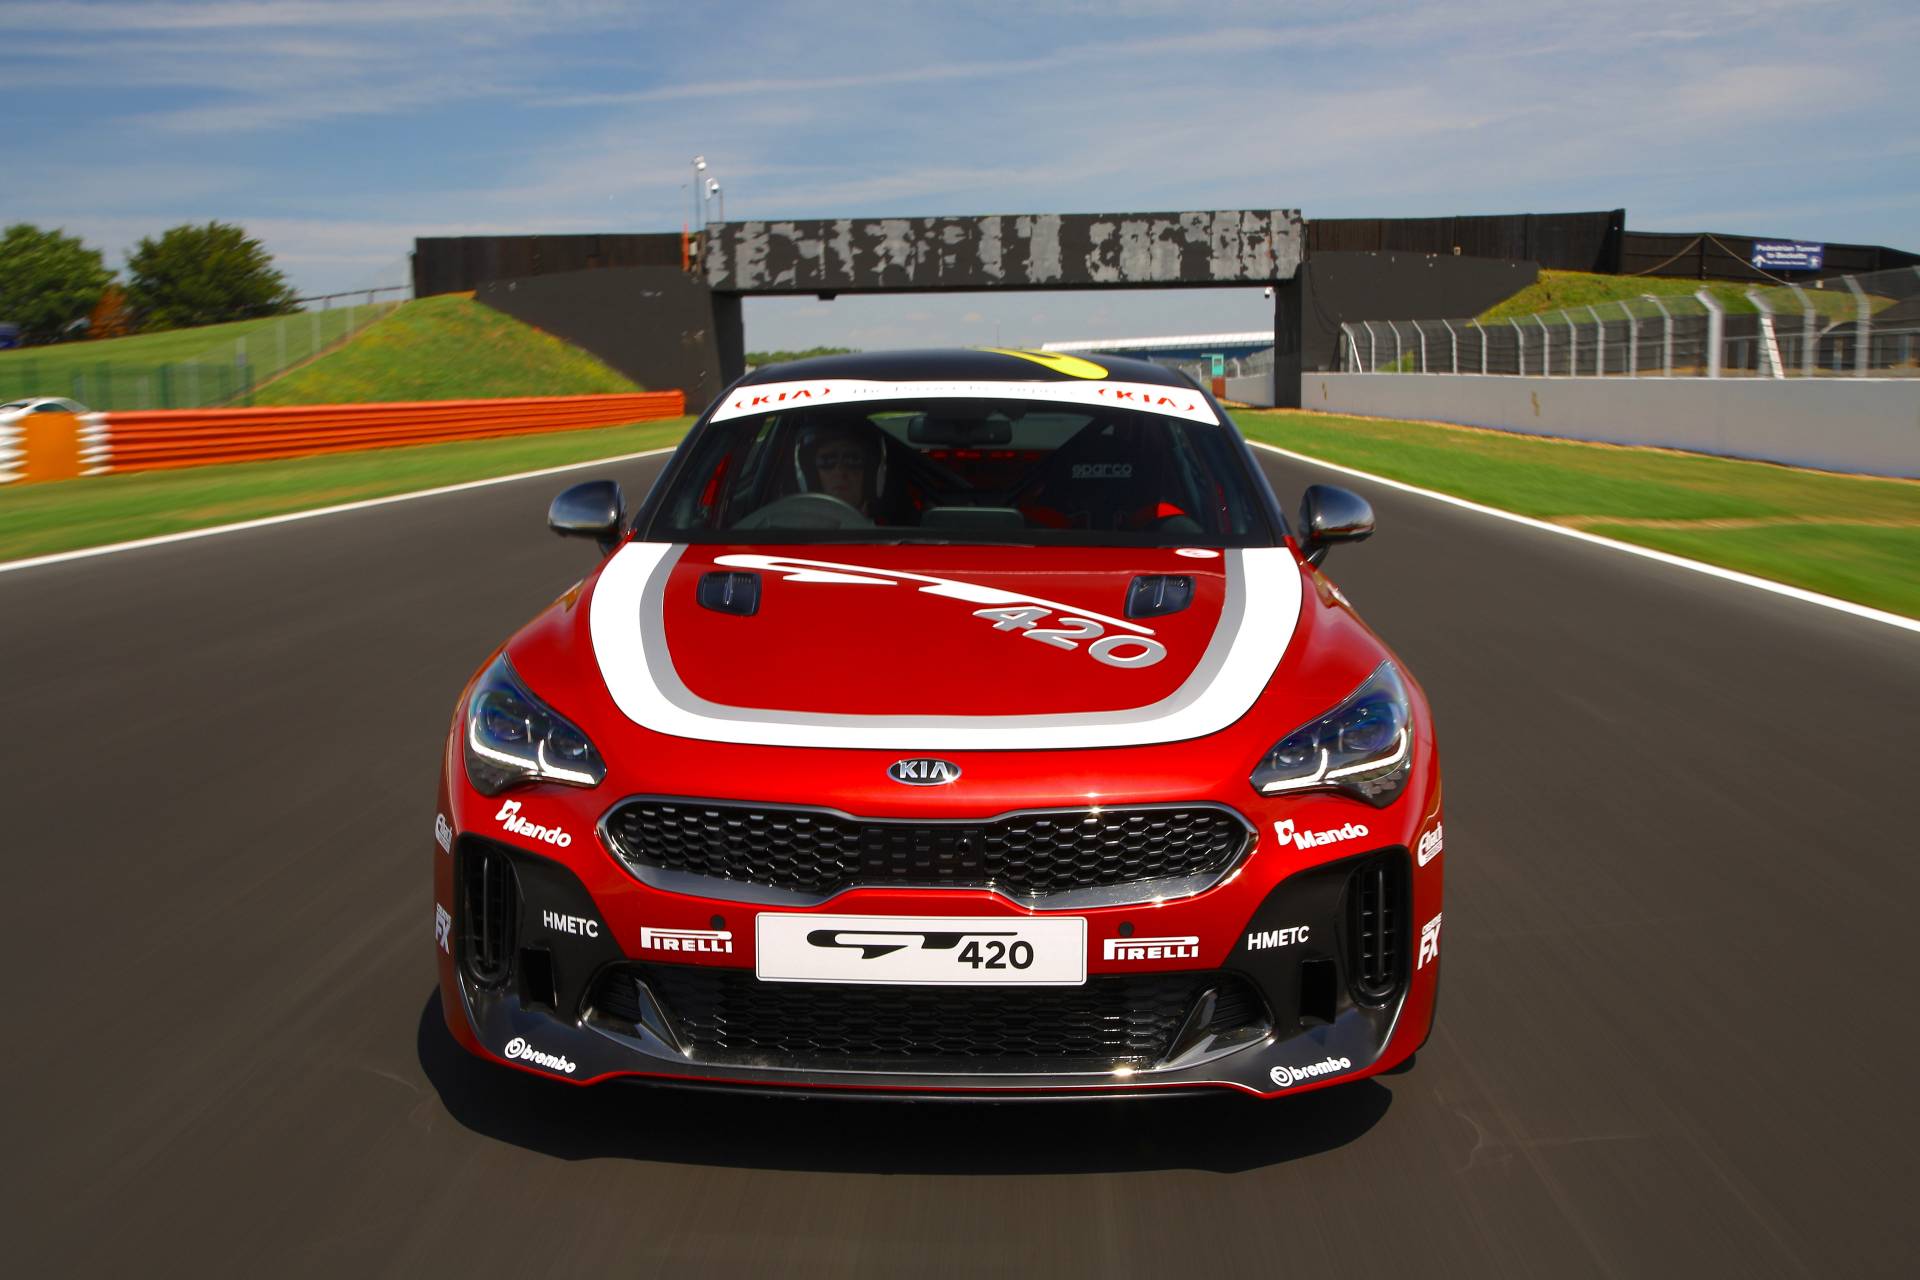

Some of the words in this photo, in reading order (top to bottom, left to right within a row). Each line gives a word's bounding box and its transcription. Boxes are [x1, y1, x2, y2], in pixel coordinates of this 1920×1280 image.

[1795, 244, 1821, 253] Tunnel
[751, 389, 812, 406] KIA
[1115, 390, 1178, 408] KIA
[1071, 463, 1133, 477] sparco
[972, 605, 1168, 669] 420
[899, 761, 951, 780] KIA
[502, 814, 572, 848] Mando
[1292, 822, 1369, 850] Mando
[543, 909, 599, 938] HMETC
[640, 926, 733, 954] PIRELLI
[1103, 935, 1200, 960] PIRELLI
[1247, 925, 1310, 951] HMETC
[1417, 921, 1442, 970] FX
[957, 940, 1034, 970] 420
[520, 1043, 577, 1074] brembo
[1288, 1056, 1351, 1081] brembo
